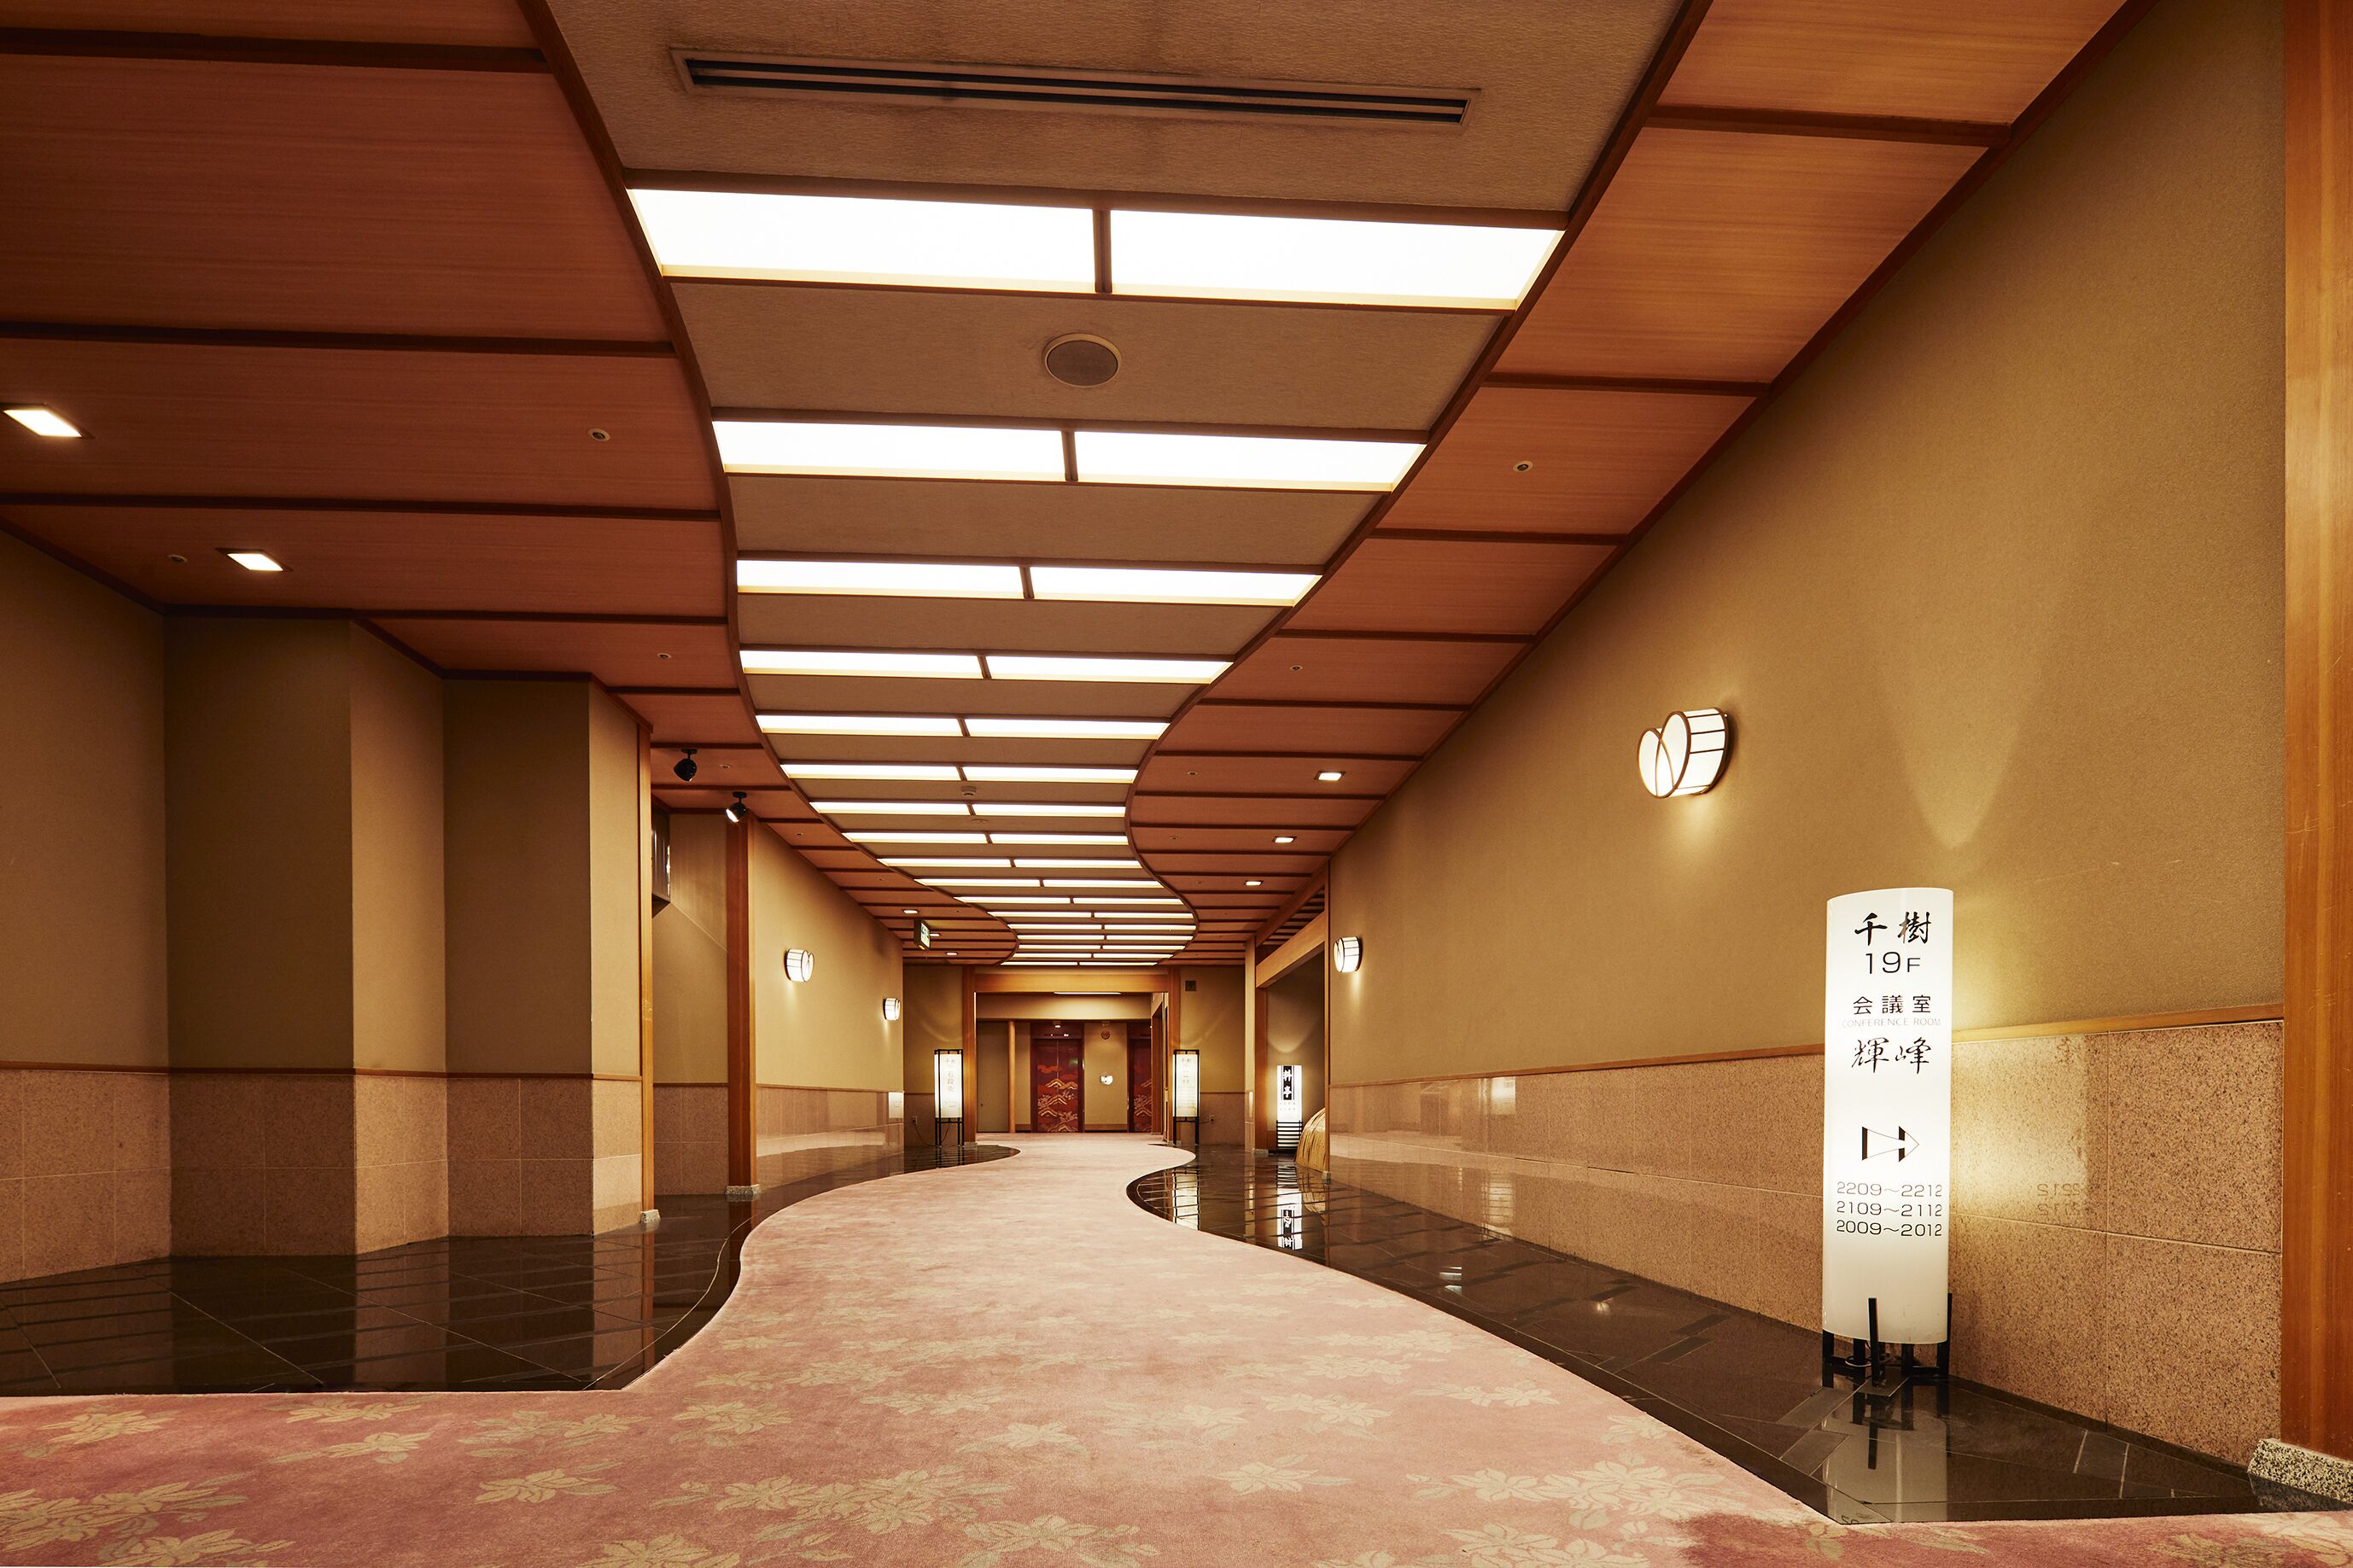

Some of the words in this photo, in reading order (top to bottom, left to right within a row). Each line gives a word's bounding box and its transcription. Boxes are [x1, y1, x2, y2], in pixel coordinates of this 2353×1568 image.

[1854, 911, 1931, 947] 千樹
[1865, 951, 1921, 975] 19F
[1853, 994, 1931, 1015] 会議室
[1842, 1017, 1910, 1029] CONFERENCE
[1913, 1017, 1941, 1027] ROOM
[1851, 1036, 1931, 1075] 輝峰
